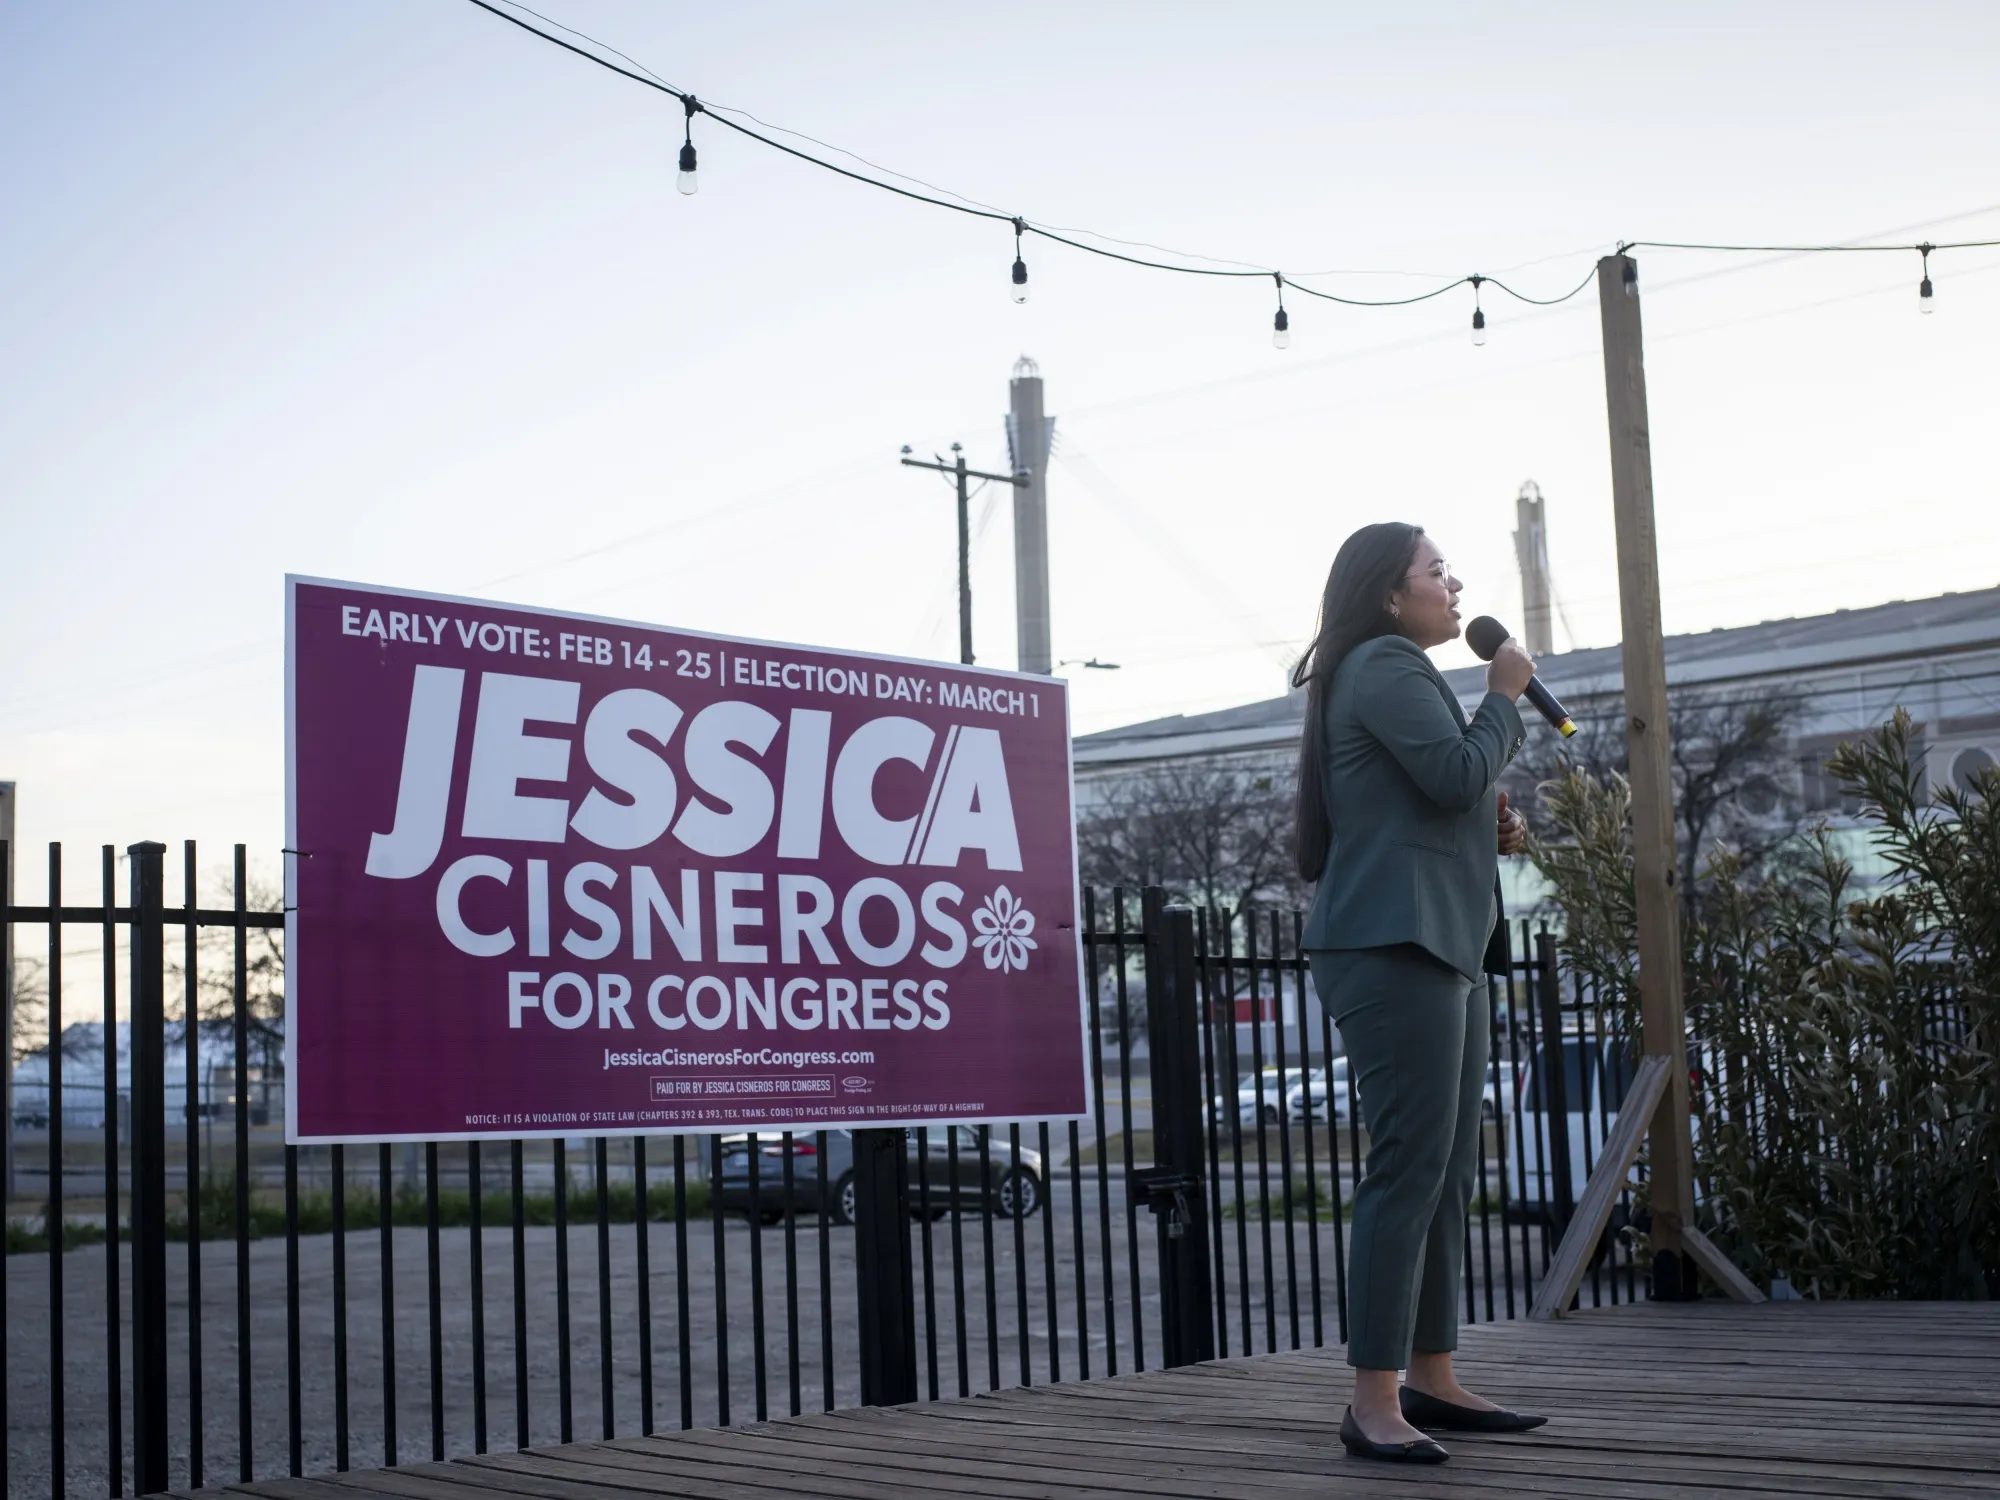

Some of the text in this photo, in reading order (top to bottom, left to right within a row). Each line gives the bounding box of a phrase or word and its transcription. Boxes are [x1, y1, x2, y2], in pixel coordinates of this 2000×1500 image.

[341, 605, 449, 646] EARLY
[454, 618, 551, 659] VOTE:
[559, 632, 613, 667] FEB
[620, 640, 653, 672] 14
[676, 650, 711, 680] 25
[734, 657, 868, 698] ELECTION
[874, 673, 932, 705] DAY:
[939, 682, 1025, 717] MARCH
[1030, 694, 1039, 718] 1
[365, 664, 1023, 880] JESSICA
[435, 854, 968, 968] CISNEROS
[508, 972, 951, 1030] FOR CONGRESS
[603, 1048, 875, 1070] JessicaCisnerosForCongress.com
[656, 1082, 674, 1095] PAID
[676, 1082, 691, 1094] FOR
[693, 1082, 703, 1094] BY
[704, 1081, 735, 1094] JESSICA
[736, 1081, 773, 1093] CISNEROS
[775, 1080, 790, 1092] FOR
[792, 1080, 831, 1092] CONGRESS
[465, 1114, 500, 1125] NOTICE:
[503, 1114, 512, 1124] IT
[514, 1114, 523, 1124] IS
[524, 1114, 531, 1123] A
[533, 1112, 577, 1124] VIOLATION
[580, 1112, 591, 1122] OF
[593, 1112, 616, 1122] STATE
[618, 1111, 635, 1121] LAW
[681, 1110, 696, 1119] 392
[724, 1109, 740, 1118] TEX.
[742, 1108, 769, 1118] TRANS.
[795, 1107, 804, 1116] TO
[806, 1106, 828, 1116] PLACE
[830, 1106, 846, 1115] THIS
[848, 1105, 865, 1115] SIGN
[866, 1105, 875, 1114] IN
[876, 1105, 889, 1114] THE
[939, 1103, 948, 1112] OF
[948, 1103, 954, 1112] A
[955, 1102, 985, 1112] HIGHWAY
